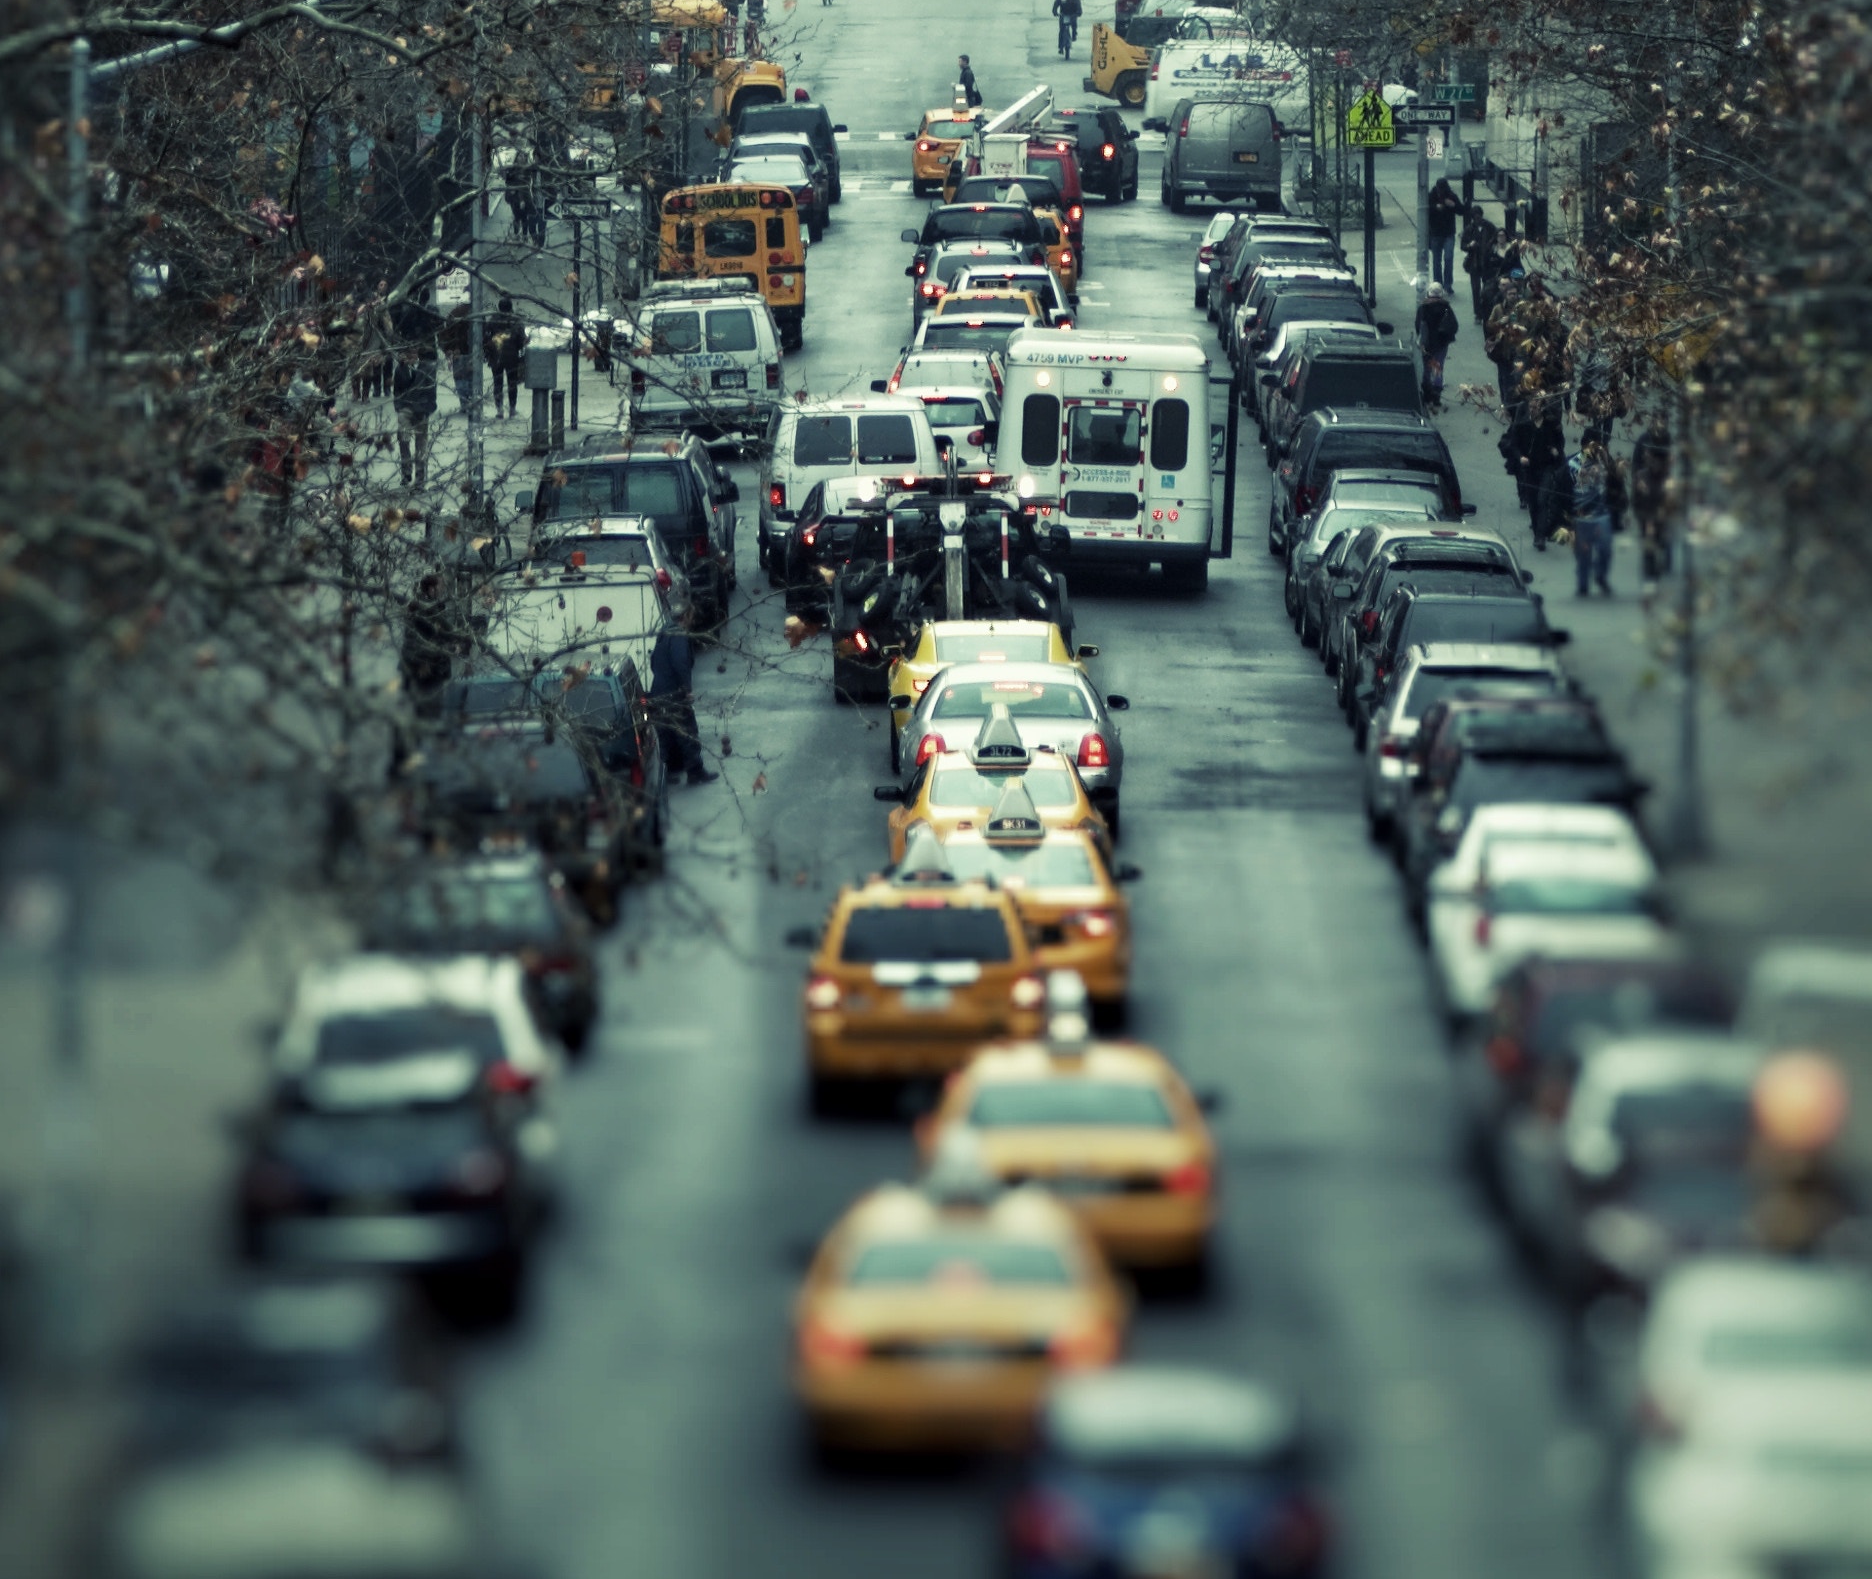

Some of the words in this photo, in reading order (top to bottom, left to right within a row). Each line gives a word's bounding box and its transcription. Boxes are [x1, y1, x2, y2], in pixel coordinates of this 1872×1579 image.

[1434, 86, 1446, 100] W
[1449, 87, 1464, 100] 27
[1427, 110, 1447, 120] WAY
[1354, 130, 1390, 142] AHEAD
[700, 193, 736, 209] SCHOOL
[738, 192, 756, 207] BUS
[1058, 354, 1084, 365] MVP
